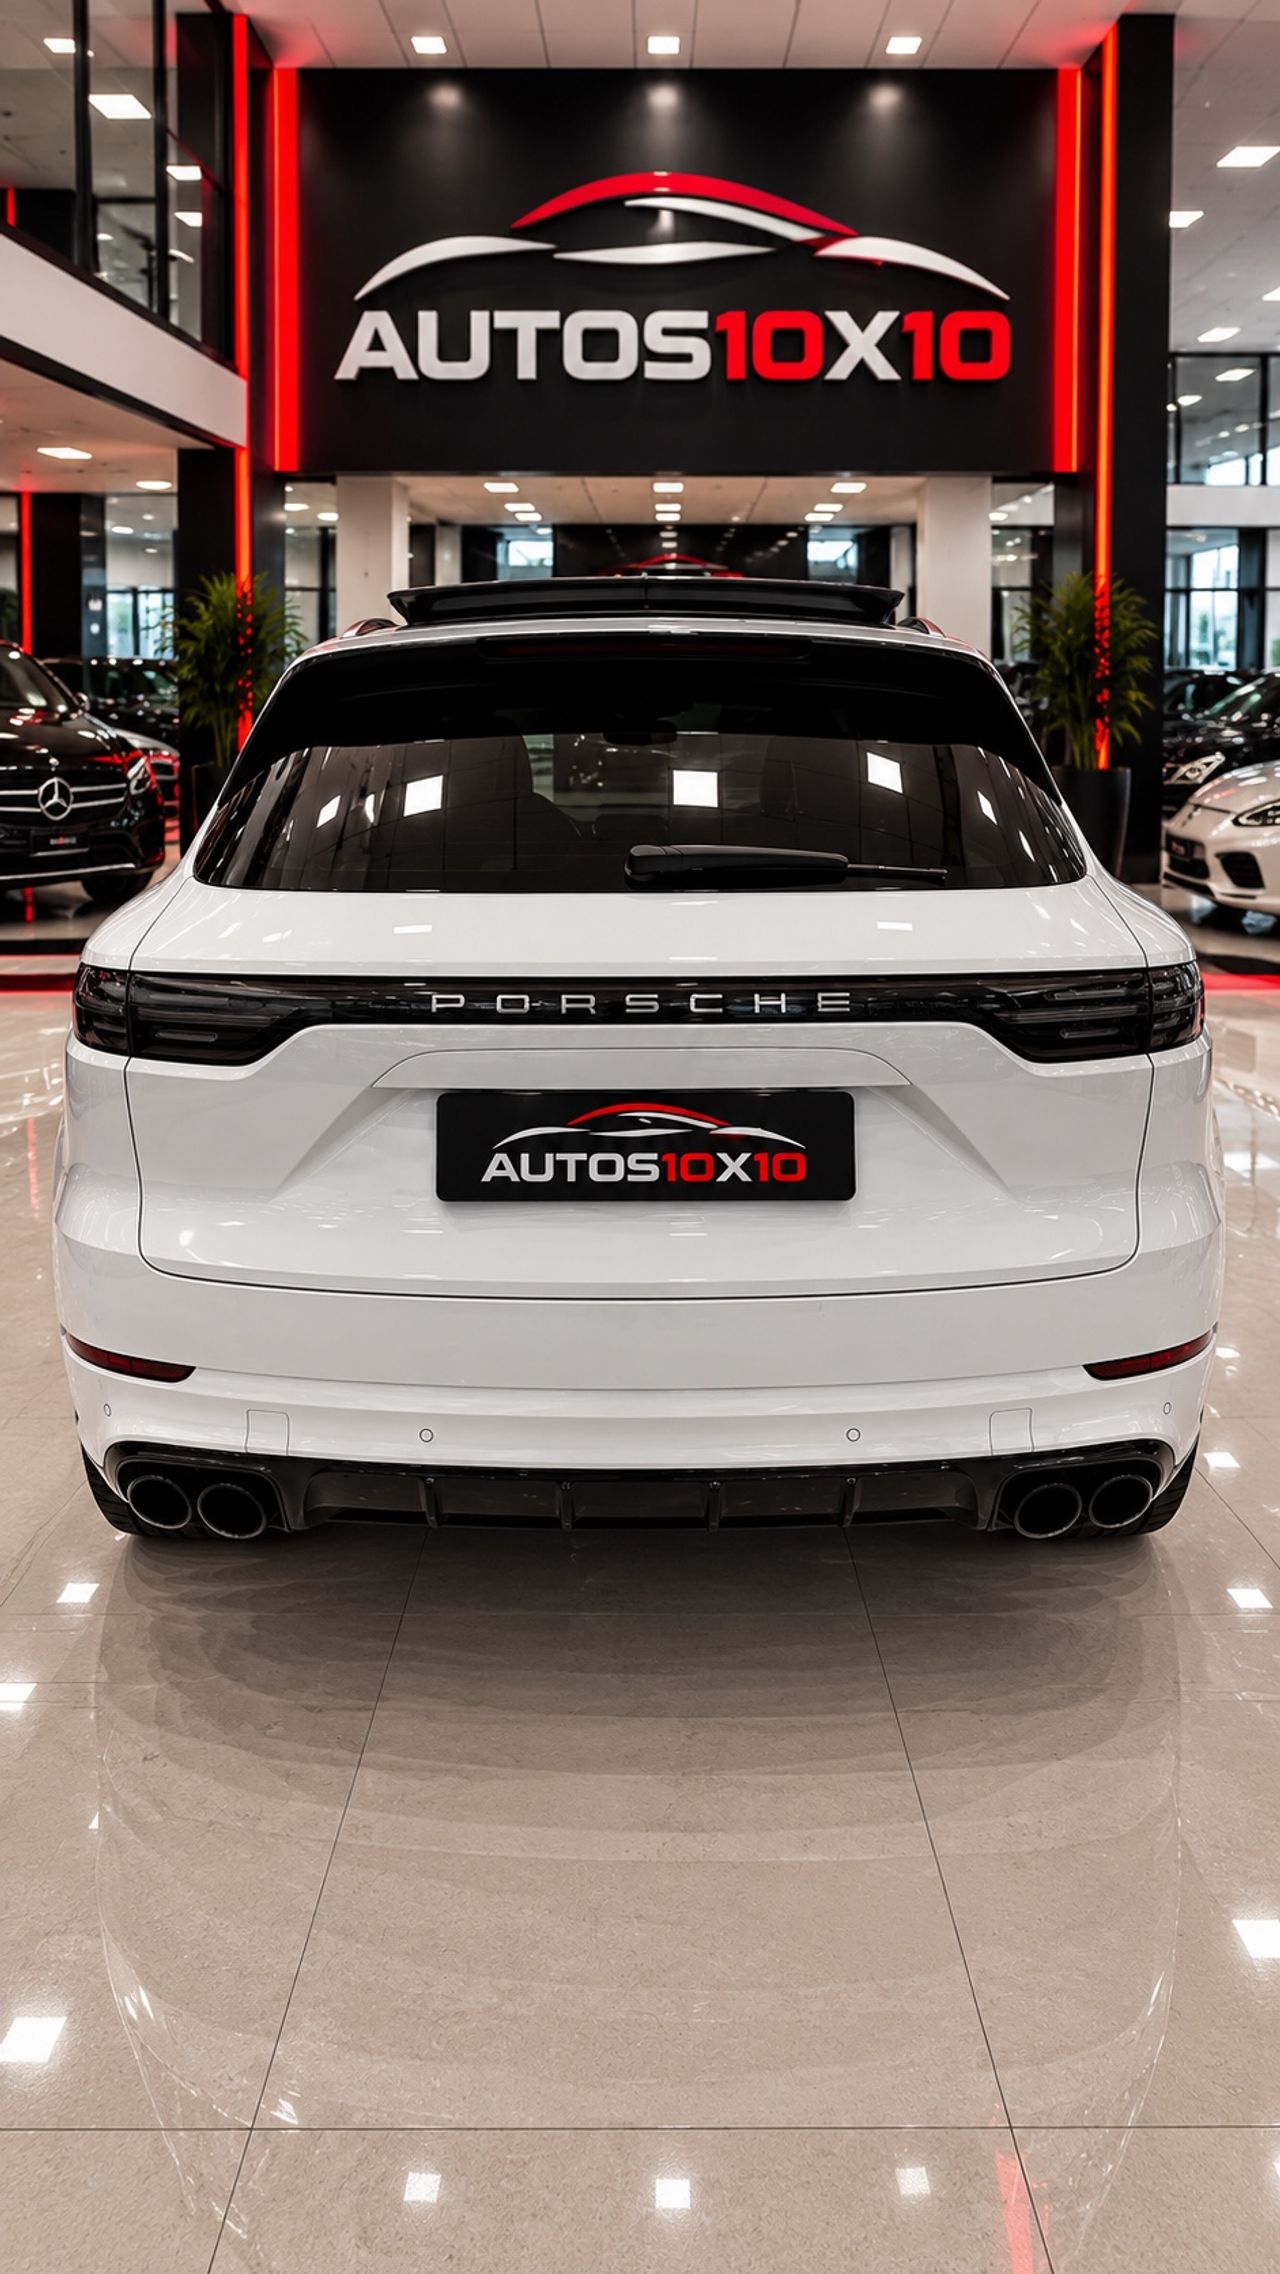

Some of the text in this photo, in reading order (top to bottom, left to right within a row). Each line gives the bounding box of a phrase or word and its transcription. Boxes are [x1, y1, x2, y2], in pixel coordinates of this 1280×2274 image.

[334, 309, 1012, 381] AUTOS10X10
[431, 992, 851, 1014] PORSCHE
[480, 1152, 807, 1182] AUTOS10X10
